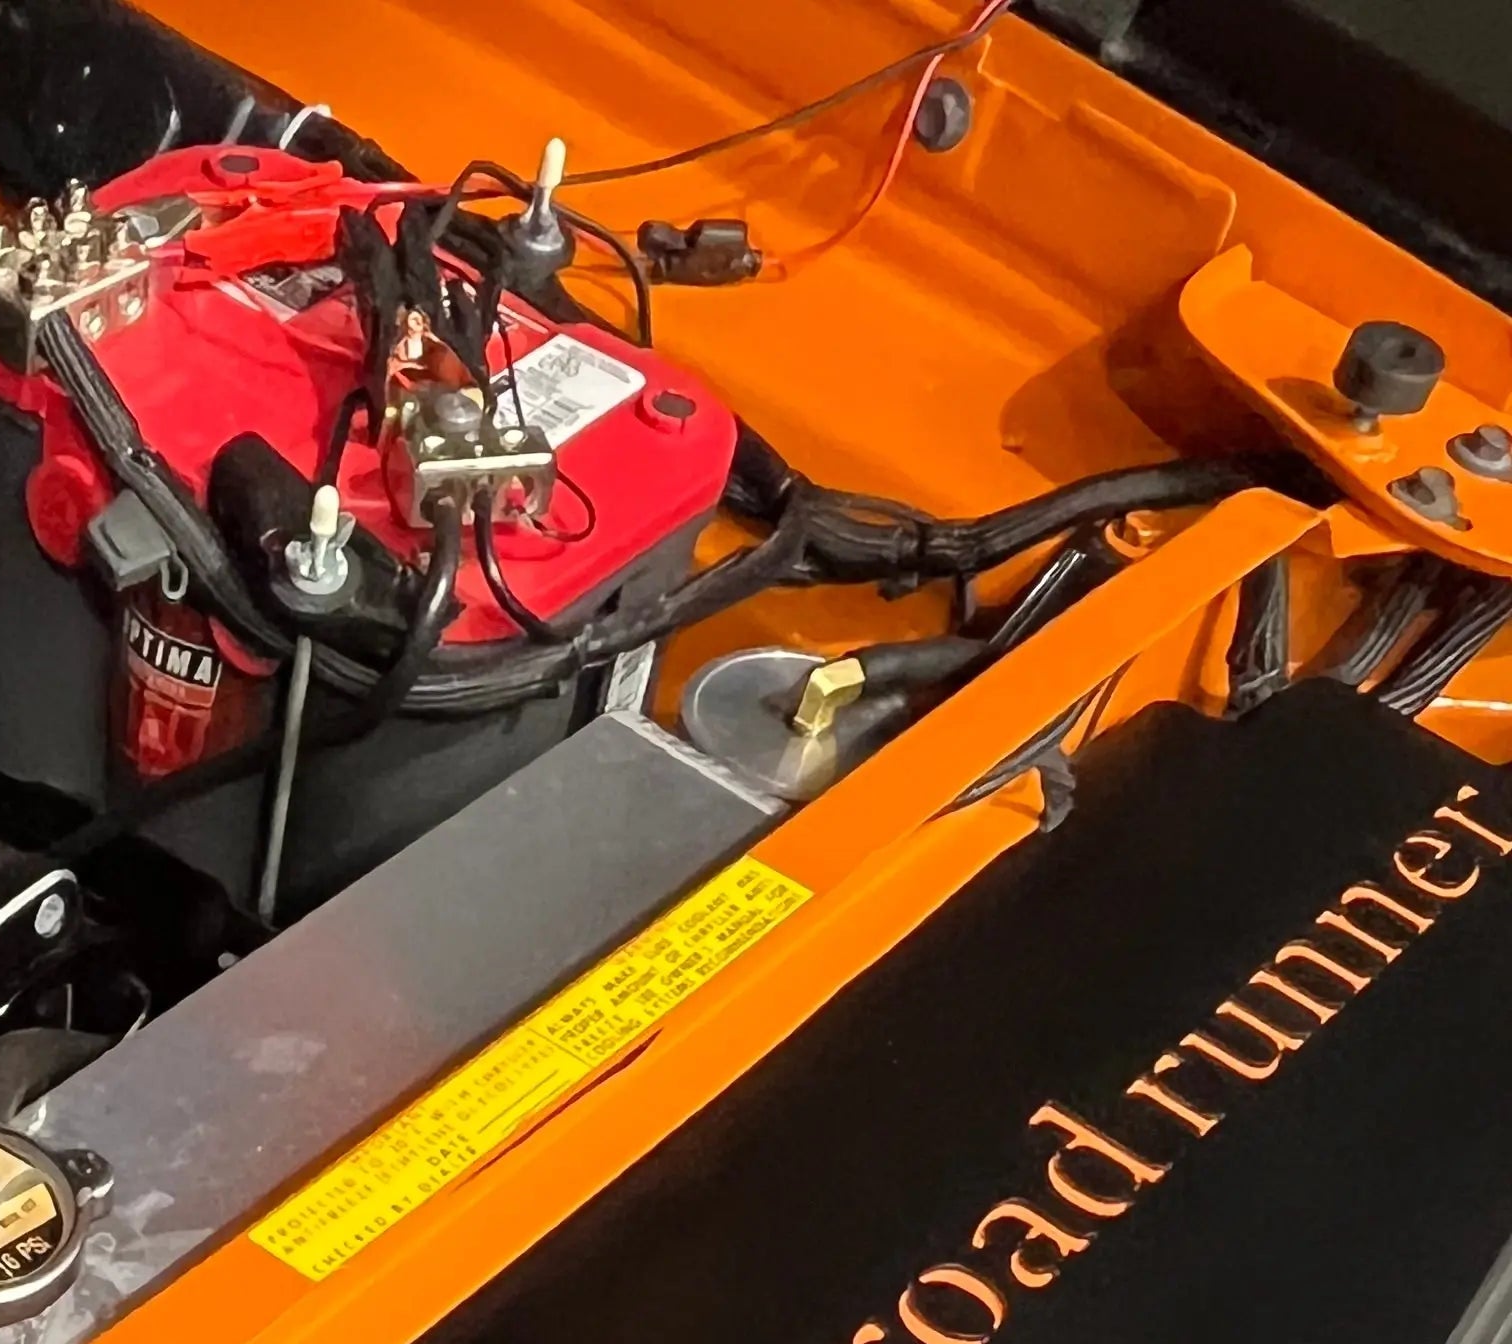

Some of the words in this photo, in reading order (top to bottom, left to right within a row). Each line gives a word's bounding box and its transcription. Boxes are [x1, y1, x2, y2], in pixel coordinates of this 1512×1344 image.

[123, 608, 213, 684] PTIMA
[1126, 784, 1512, 1138] runner
[425, 1133, 470, 1168] DATE
